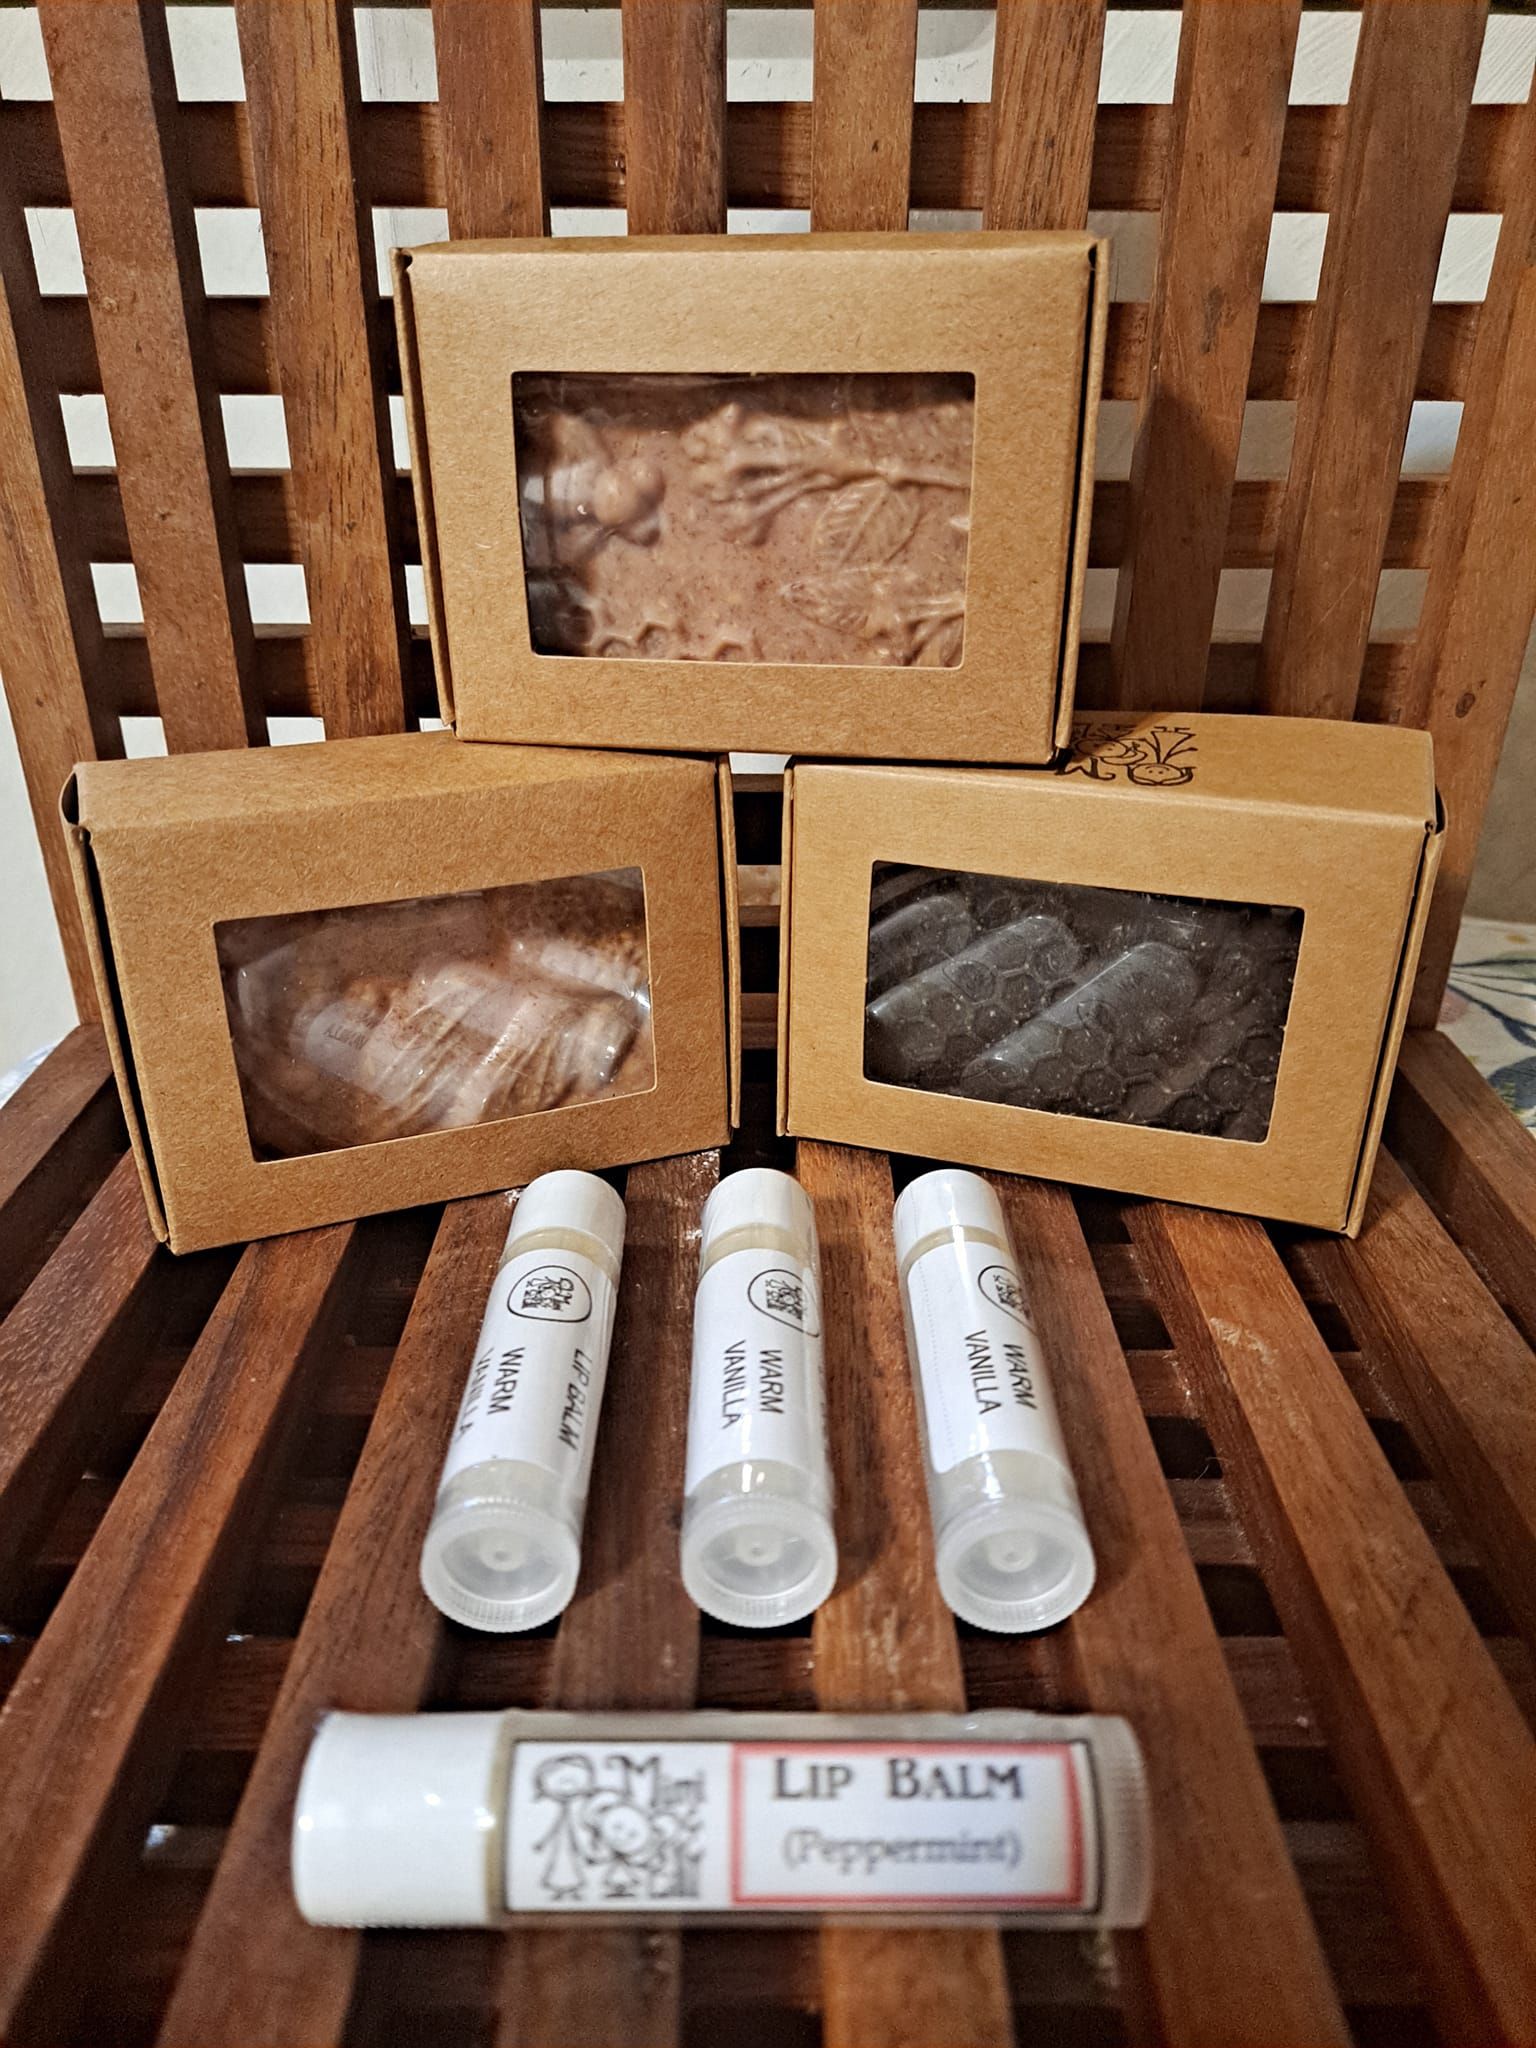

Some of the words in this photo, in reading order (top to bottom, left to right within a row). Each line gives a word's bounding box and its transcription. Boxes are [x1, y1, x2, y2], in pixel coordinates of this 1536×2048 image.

[486, 1346, 526, 1416] WARM
[570, 1347, 593, 1389] LIP
[721, 1339, 747, 1431] VANILLA
[759, 1349, 785, 1414] WARM
[964, 1329, 1003, 1415] VANILLA
[1002, 1343, 1038, 1411] WARM
[559, 1383, 587, 1452] BALM
